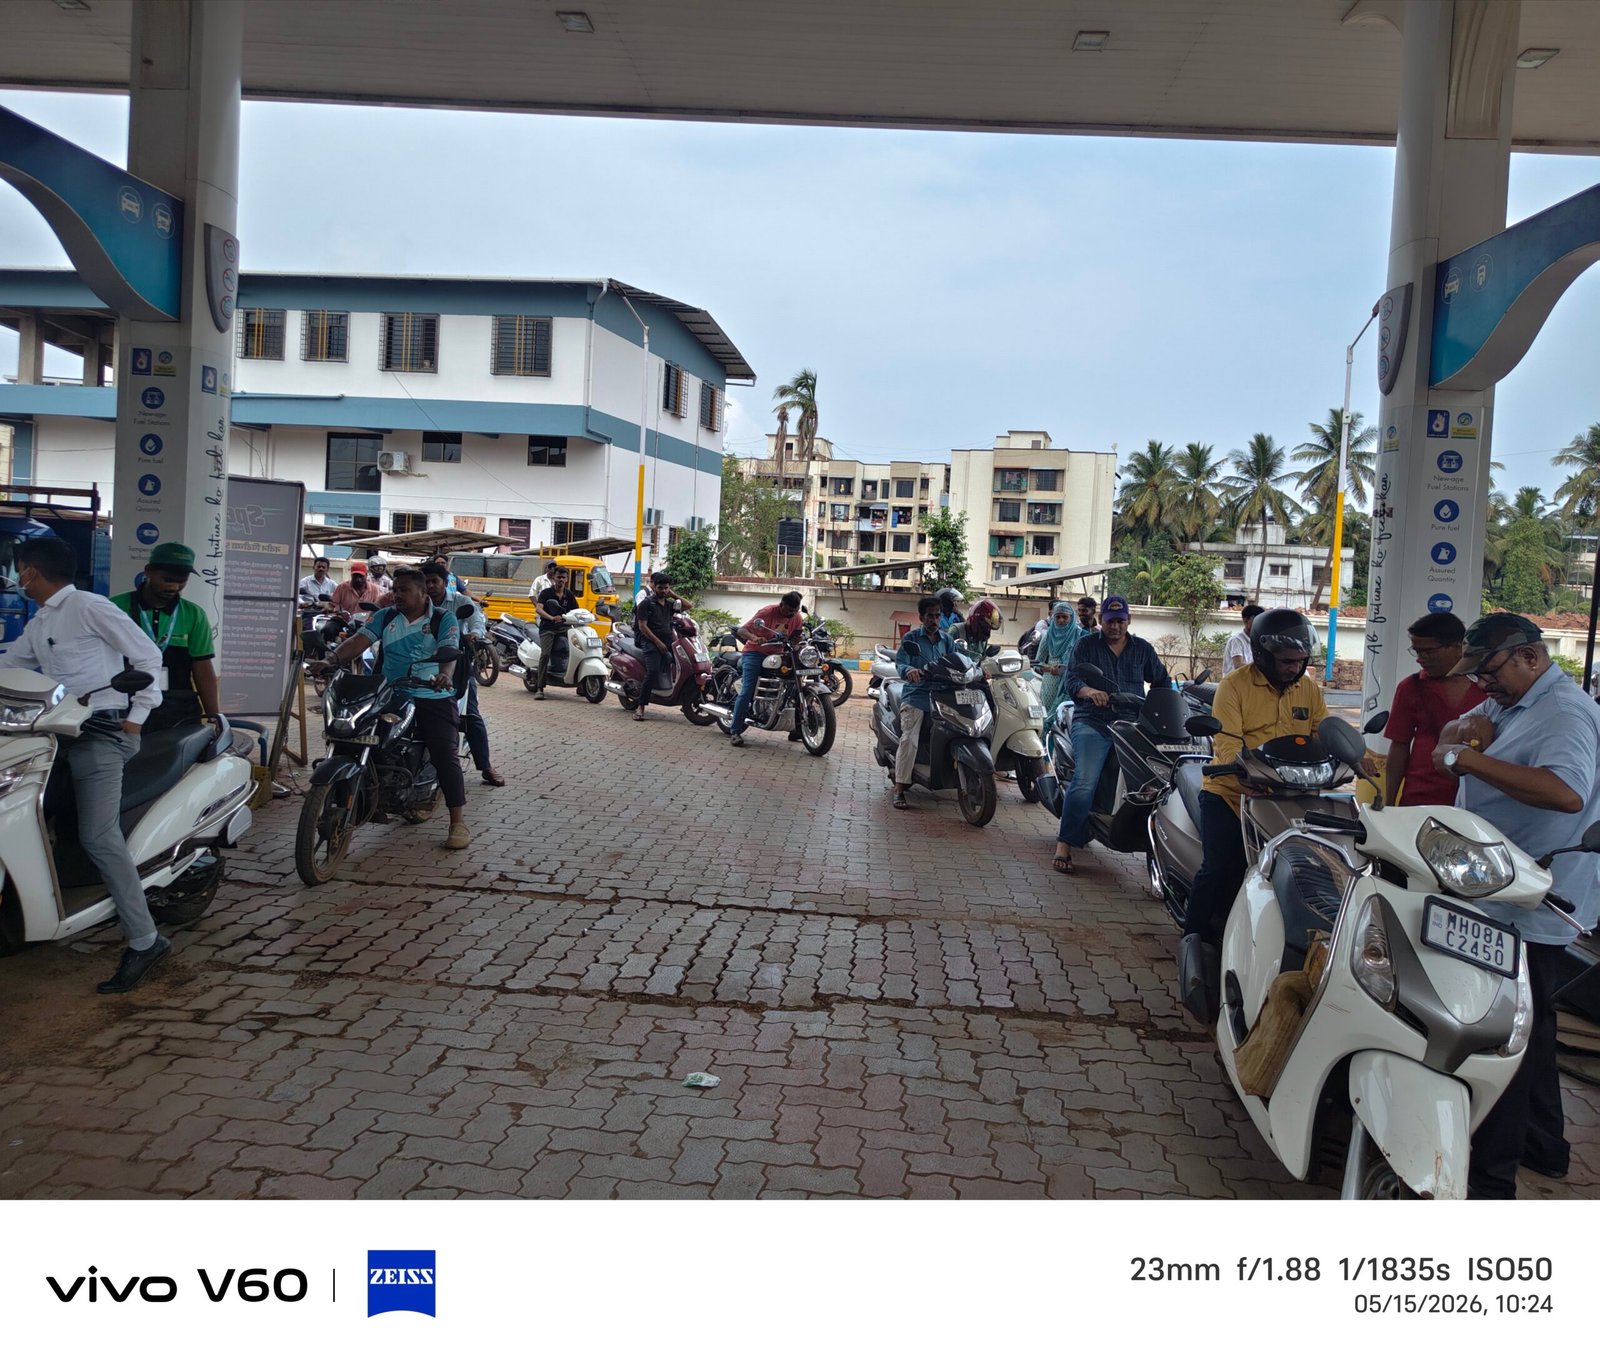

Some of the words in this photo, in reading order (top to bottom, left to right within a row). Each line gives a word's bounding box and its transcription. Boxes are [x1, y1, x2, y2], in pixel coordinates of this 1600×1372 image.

[1427, 483, 1441, 491] Fuel
[1442, 484, 1469, 492] Stations
[1431, 523, 1446, 531] Pure
[1427, 575, 1456, 584] Quantity
[1448, 912, 1504, 949] MH08A
[1446, 931, 1504, 966] C2450
